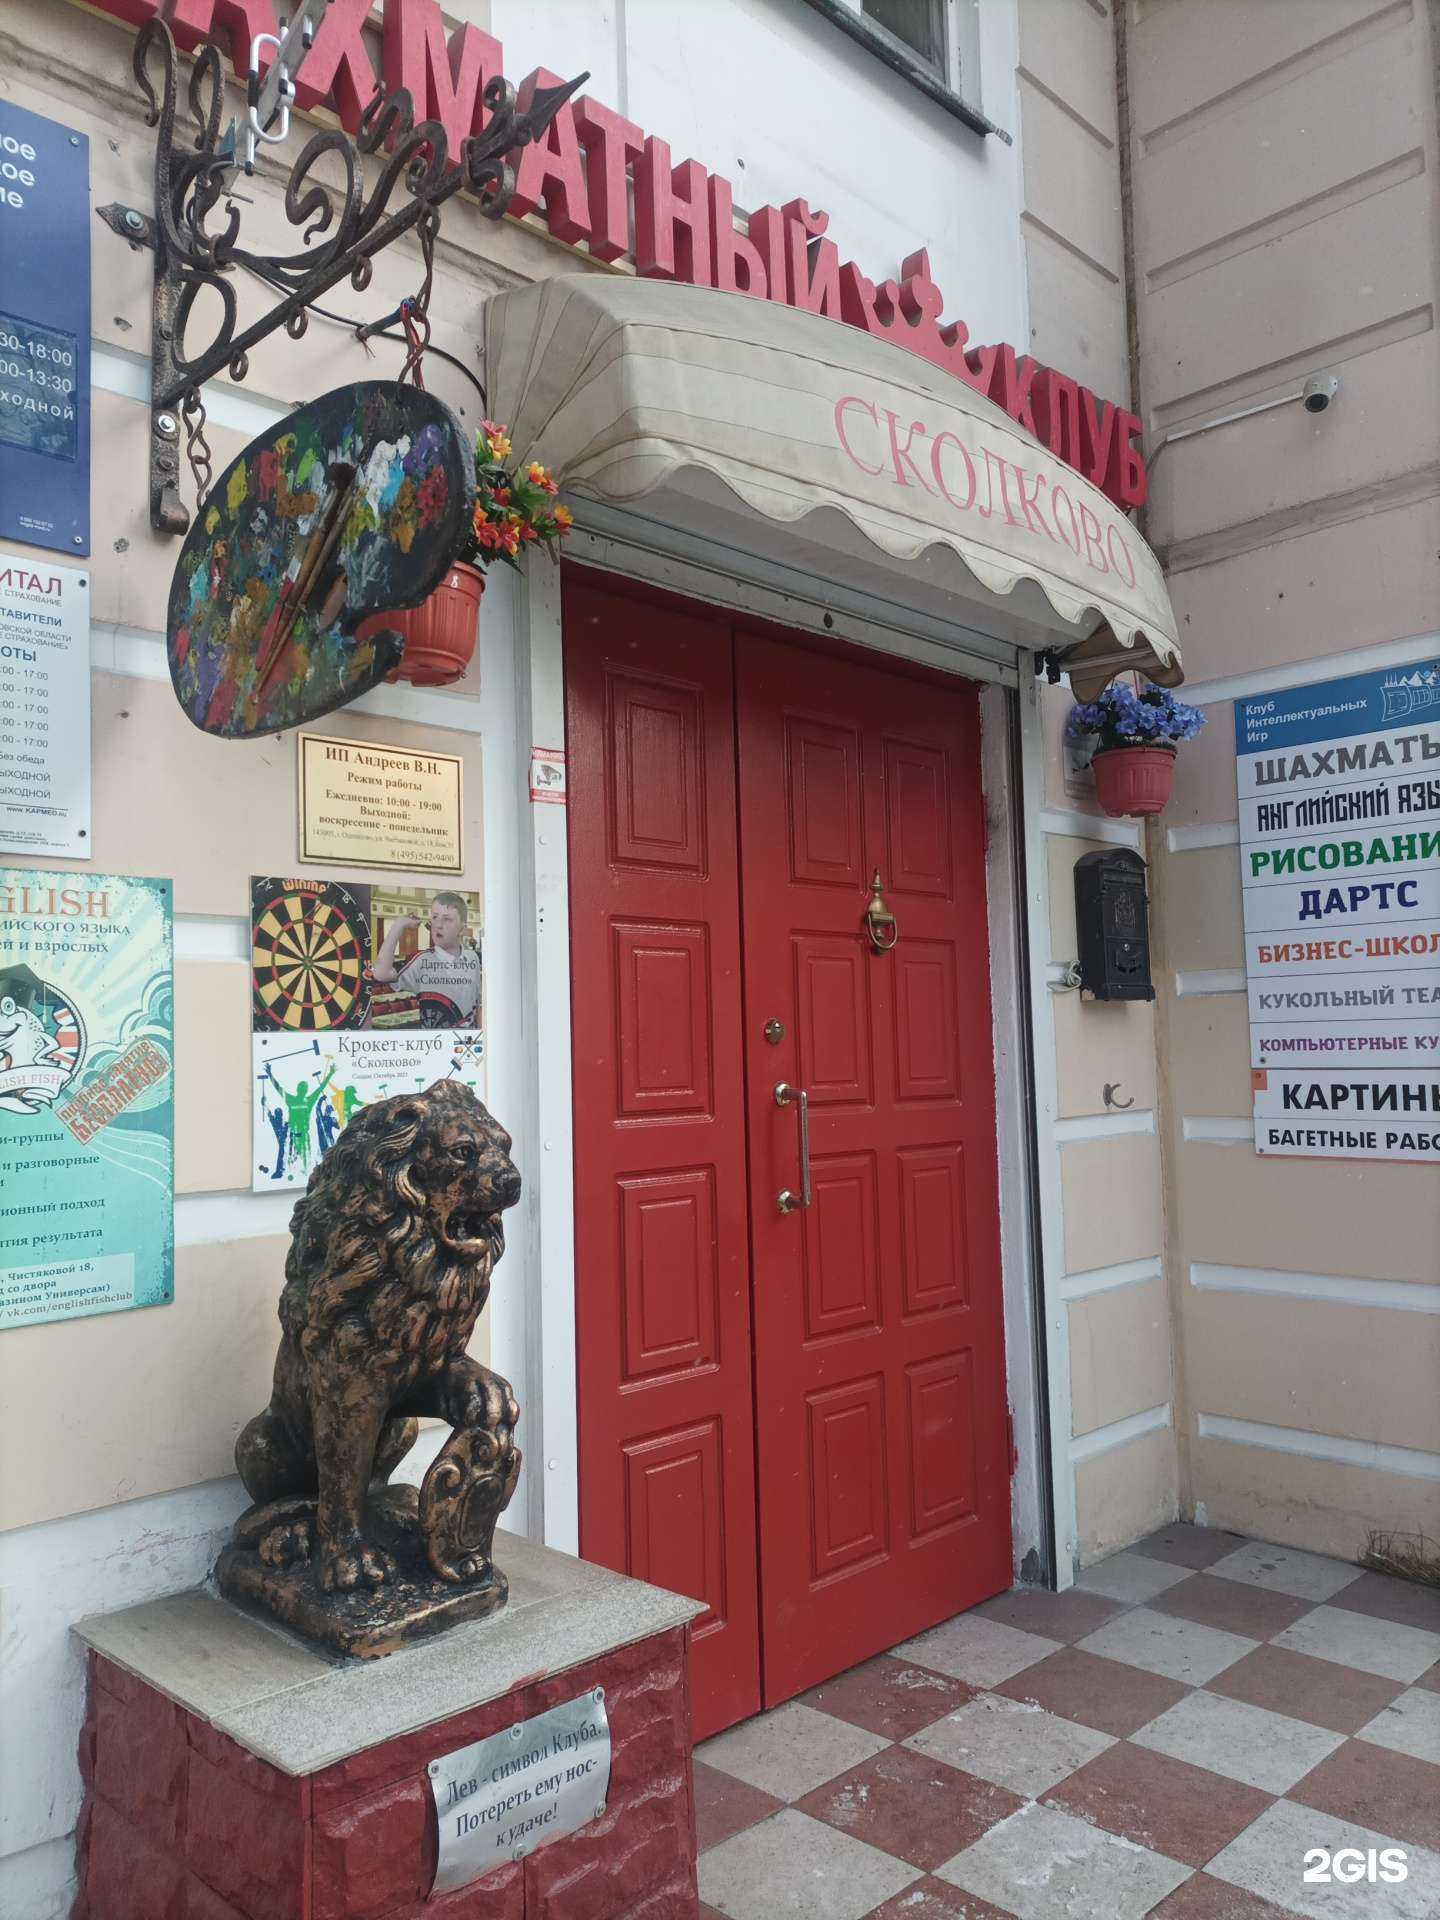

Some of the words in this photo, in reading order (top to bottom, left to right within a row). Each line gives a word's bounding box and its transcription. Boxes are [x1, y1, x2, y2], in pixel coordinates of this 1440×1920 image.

[0, 133, 37, 161] ое
[0, 160, 35, 187] ое
[140, 0, 842, 325] ХМАТНЫЙ
[990, 341, 1147, 508] КЛУБ
[834, 396, 1136, 590] СКОЛКОВО
[1246, 701, 1275, 716] Клуб
[1247, 699, 1368, 729] Интеллектуальных
[1247, 731, 1269, 743] Игр
[326, 746, 349, 762] ИП
[354, 752, 410, 771] Андреев
[414, 760, 441, 776] В.Н.
[347, 771, 383, 787] Режим
[385, 779, 422, 792] работы
[326, 788, 383, 804] Ежедневно:
[386, 796, 410, 809] 10:00
[419, 800, 442, 812] 19:00
[1257, 781, 1390, 832] АНГЛИЙСКИЙ
[360, 806, 412, 821] Выходной:
[319, 816, 381, 832] воскресение
[389, 823, 448, 837] понедельник
[1250, 831, 1440, 877] РИСОВАНИ
[1299, 880, 1419, 921] ДАРТС
[80, 922, 132, 936] ЯЗЫКА
[0, 939, 13, 951] й
[20, 941, 29, 951] и
[35, 941, 110, 955] взрослых
[419, 958, 477, 971] Дартс-клуб
[415, 974, 473, 986] «Сколково»
[1259, 985, 1394, 1009] КУКОЛЬНЫЙ
[338, 1030, 443, 1058] Крокет-клуб
[1260, 1036, 1408, 1052] КОМПЬЮТЕРНЫЕ
[351, 1055, 422, 1069] «Сколково»
[1269, 1129, 1377, 1149] БАГЕТНЫЕ
[3, 1162, 10, 1171] и
[16, 1155, 100, 1173] разговорные
[60, 1198, 106, 1211] подход
[32, 1228, 103, 1247] результата
[8, 1264, 76, 1281] Чистяковой
[79, 1262, 94, 1273] 18,
[23, 1280, 57, 1293] двора
[46, 1283, 111, 1300] Универсам)
[447, 1775, 478, 1806] Лев
[491, 1747, 550, 1783] символ
[552, 1720, 601, 1755] Клуба.
[456, 1788, 531, 1838] Потереть
[535, 1774, 562, 1796] ему
[496, 1833, 504, 1847] к
[508, 1802, 558, 1849] удаче!
